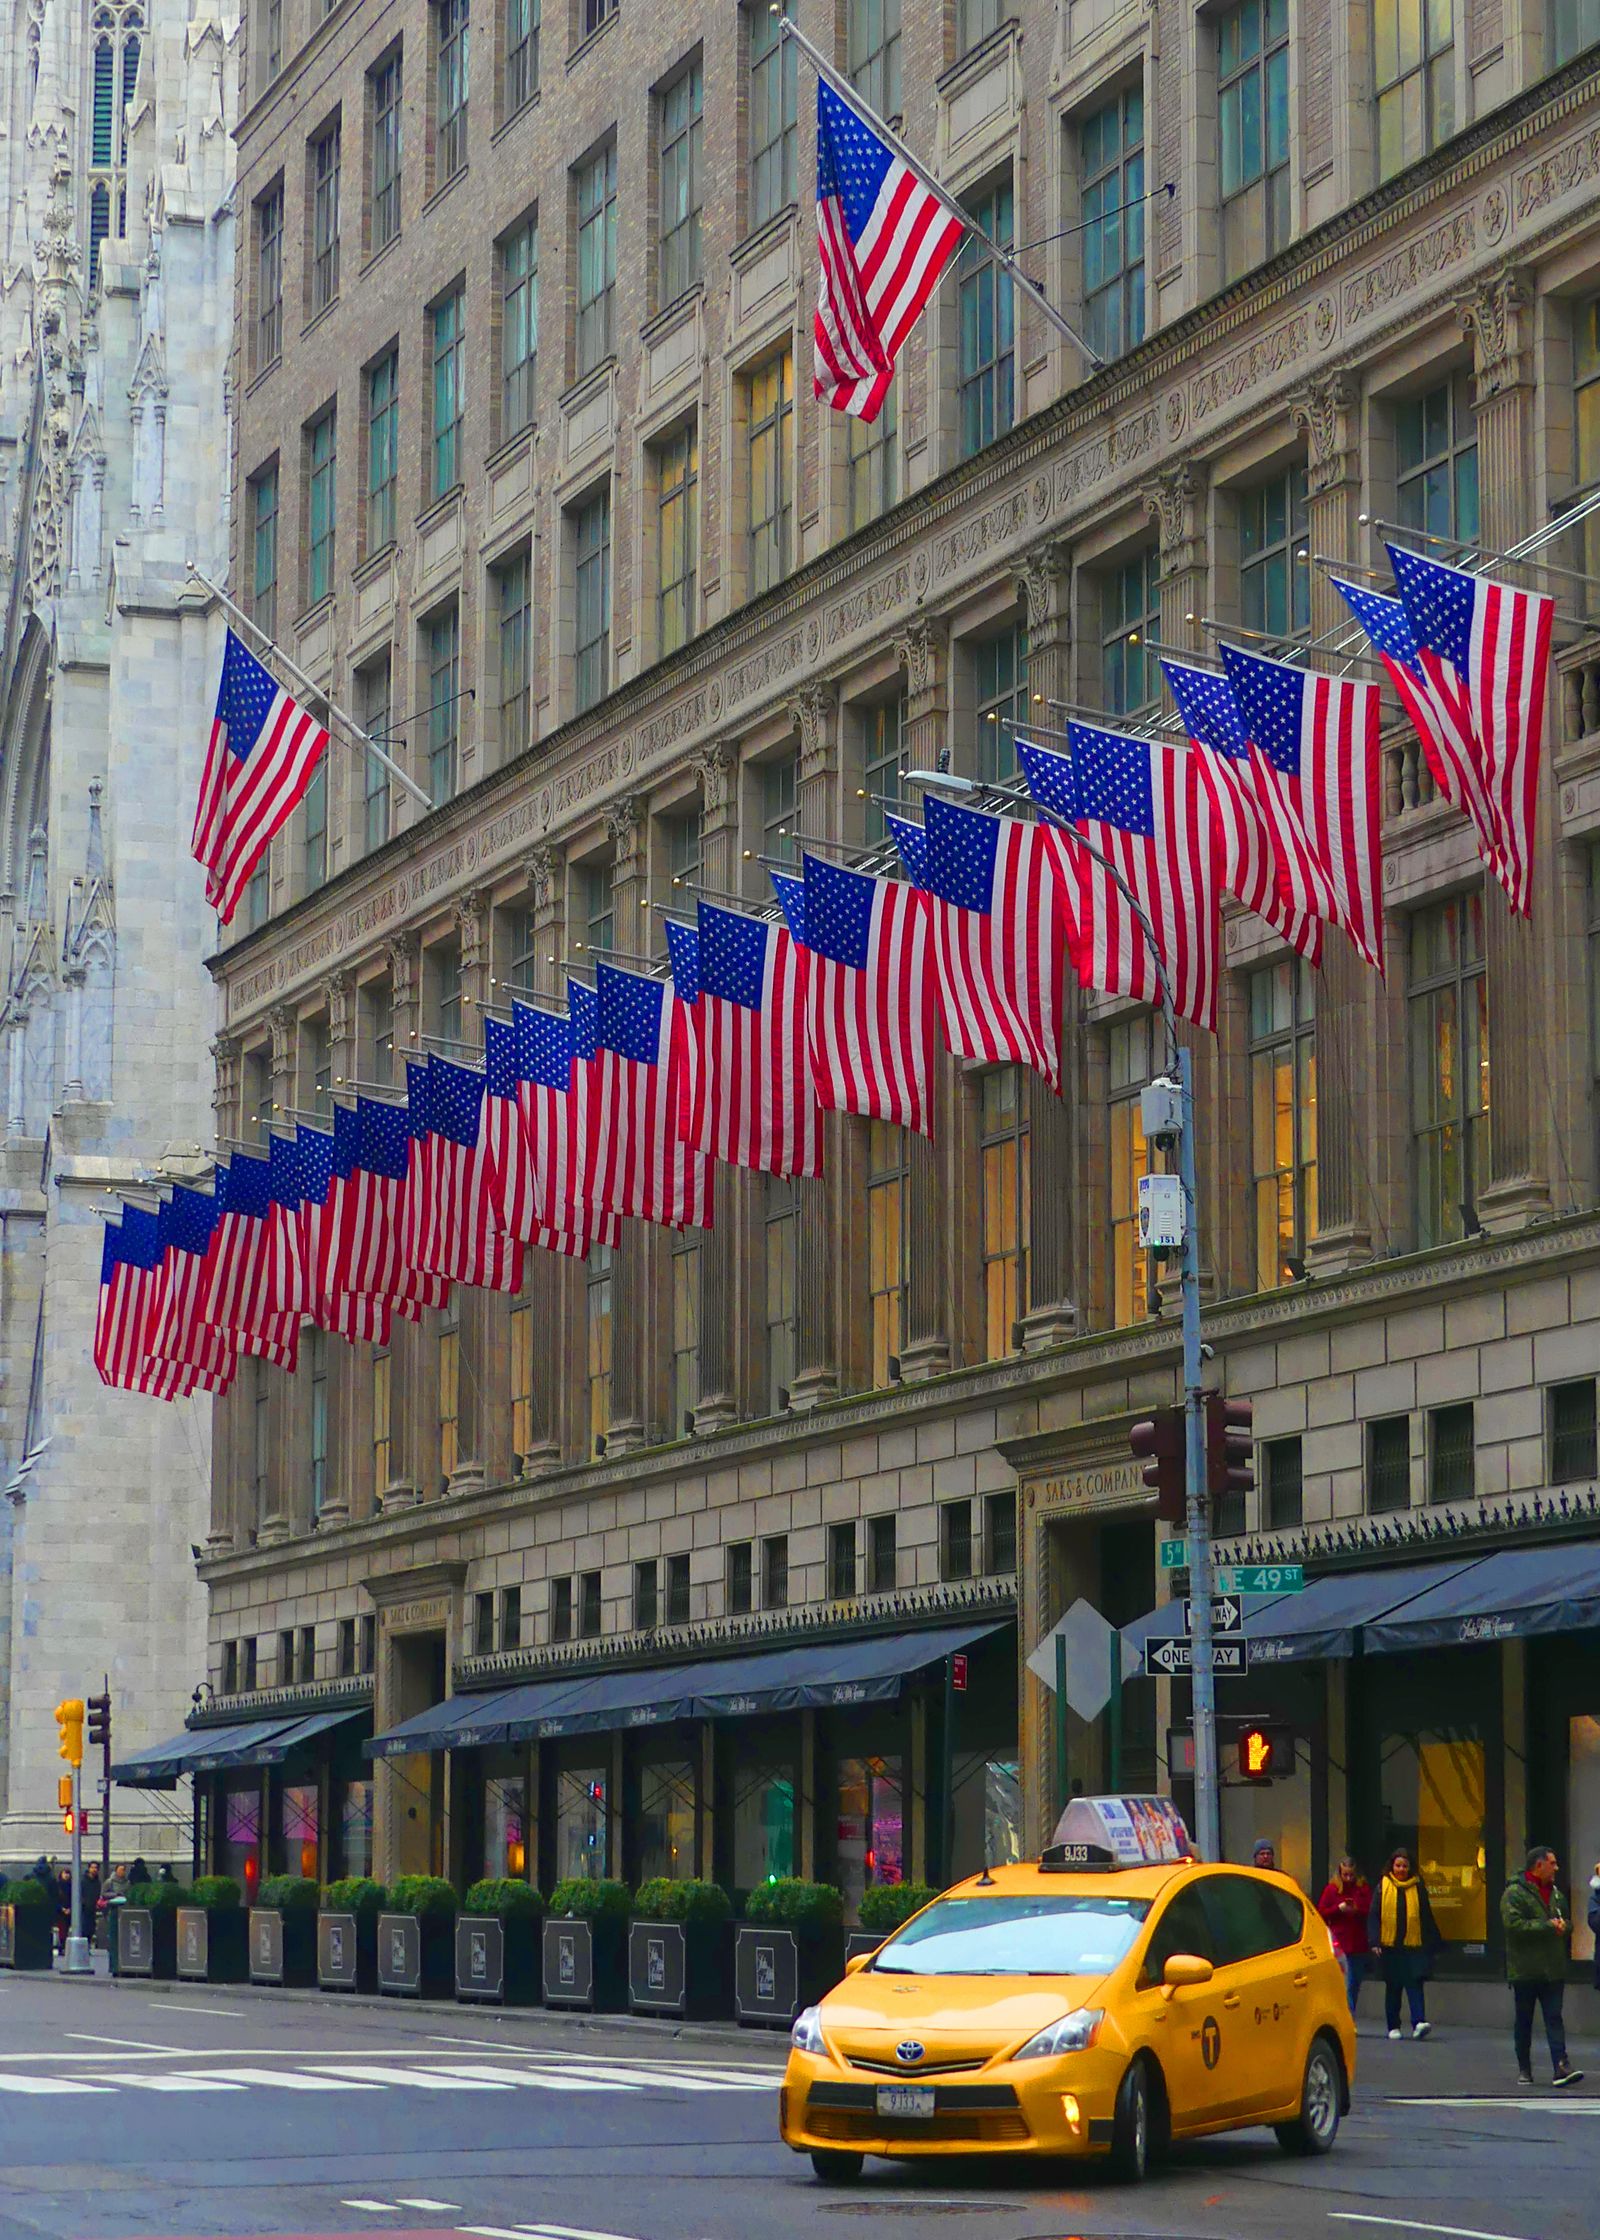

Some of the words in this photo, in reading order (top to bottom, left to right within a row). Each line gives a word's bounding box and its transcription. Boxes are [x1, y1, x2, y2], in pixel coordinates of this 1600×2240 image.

[1160, 1235, 1175, 1244] 151
[1046, 1480, 1072, 1503] SAKS
[1075, 1477, 1083, 1498] &
[1167, 1542, 1174, 1565] 5
[1233, 1569, 1245, 1591] E
[1253, 1569, 1282, 1591] 49
[1285, 1569, 1299, 1581] ST
[1214, 1606, 1233, 1622] WAY
[1162, 1649, 1190, 1664] ONE
[1212, 1649, 1233, 1664] AY
[1064, 1845, 1088, 1861] 9J33
